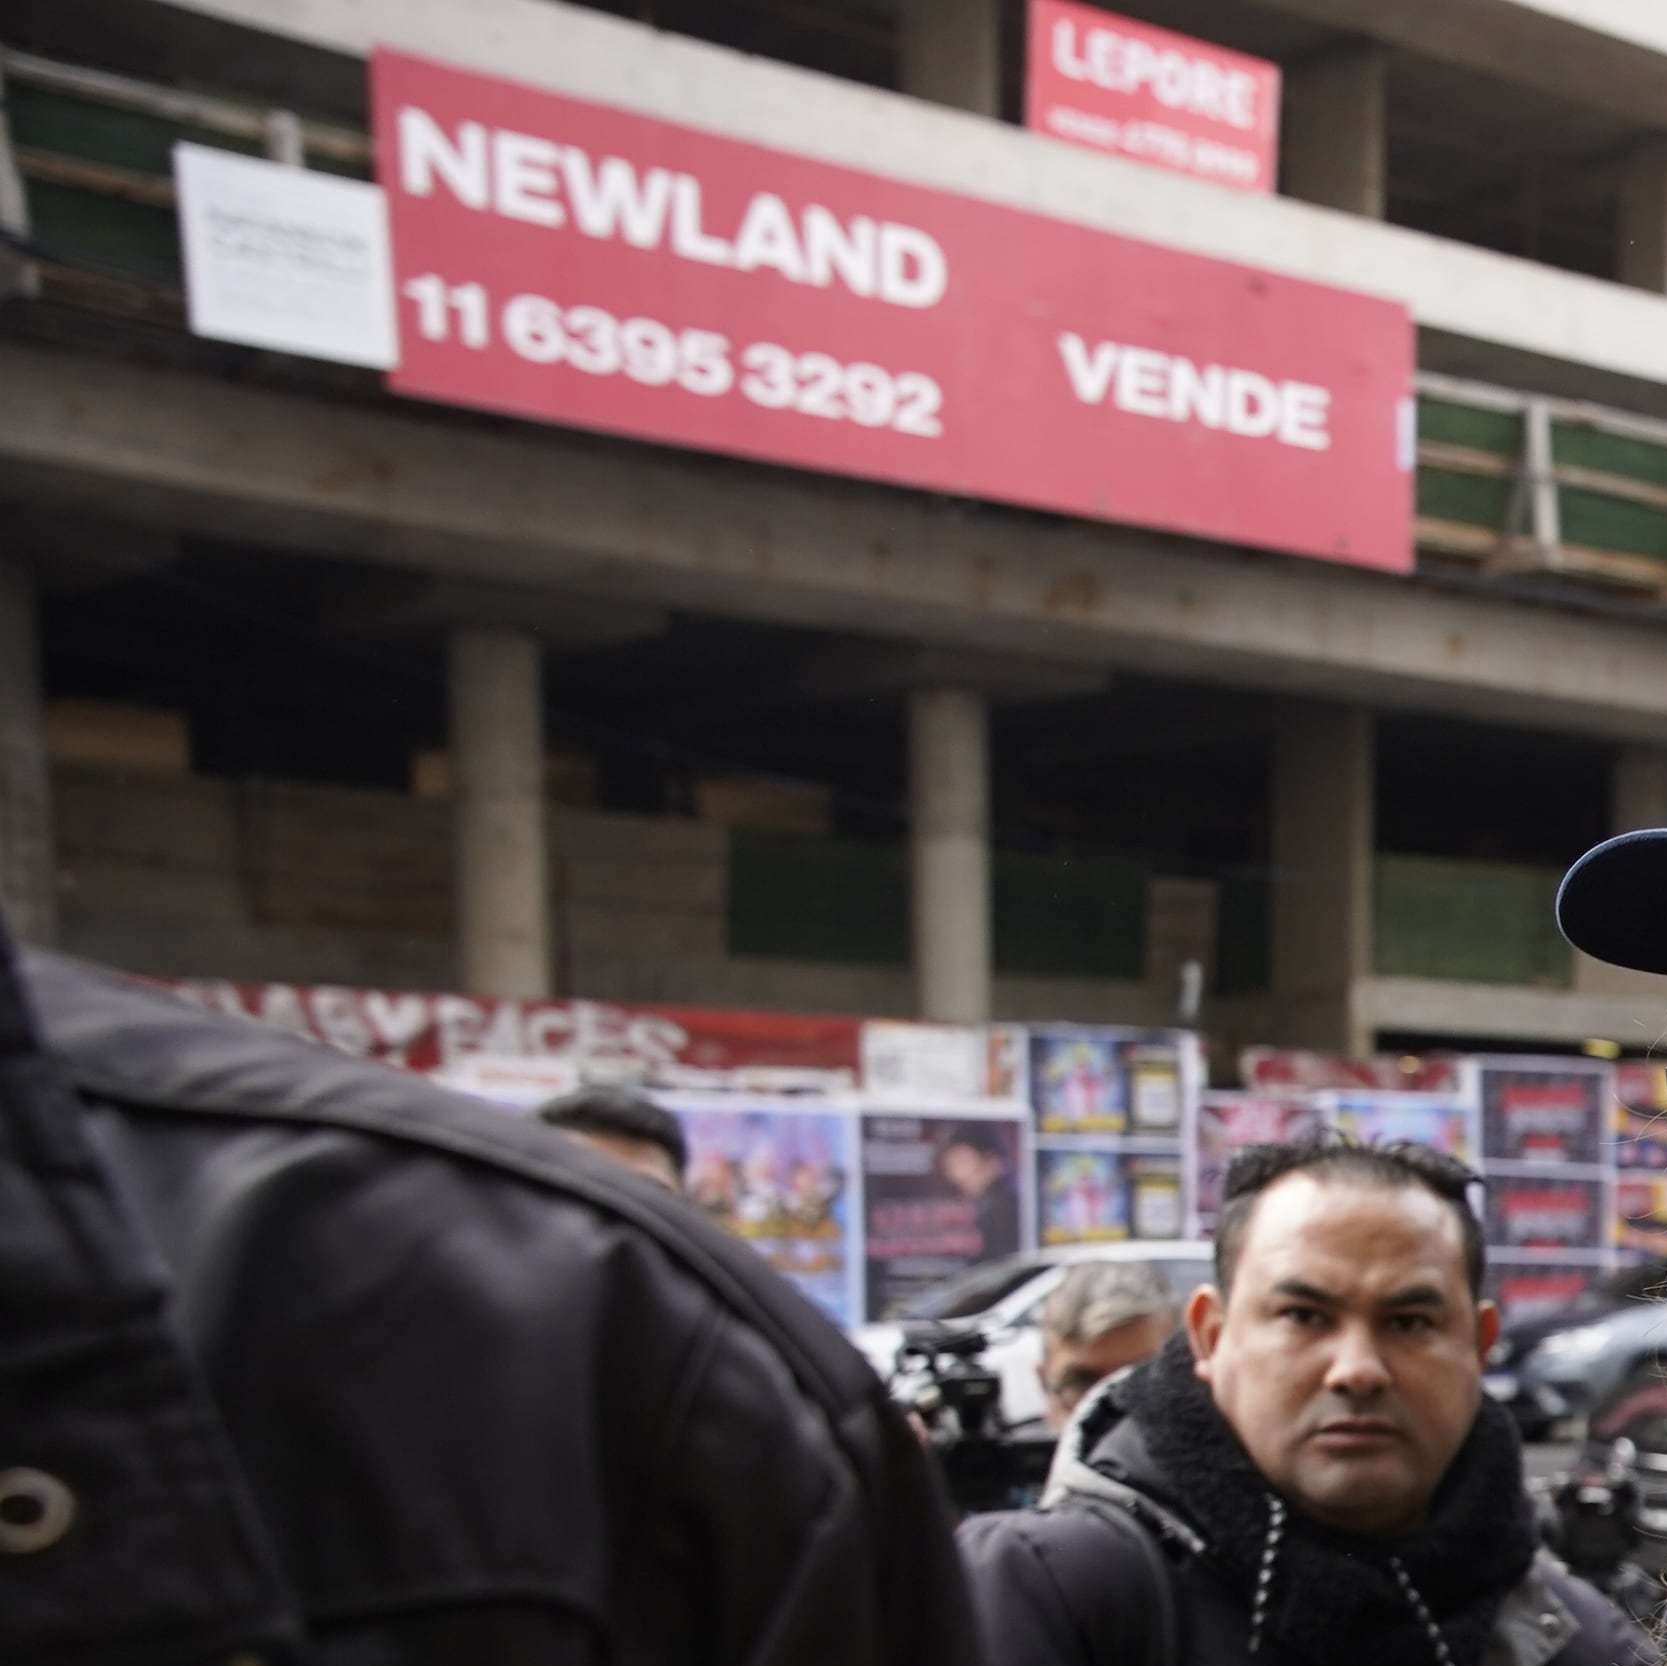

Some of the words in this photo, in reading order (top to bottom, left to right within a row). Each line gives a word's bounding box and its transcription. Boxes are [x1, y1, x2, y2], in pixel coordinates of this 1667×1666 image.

[1053, 18, 1255, 130] LEPORE
[398, 104, 946, 309] NEWLAND
[404, 272, 487, 349] 11
[503, 293, 734, 396] 6395
[740, 341, 943, 438] 3292
[1058, 330, 1330, 451] VENDE
